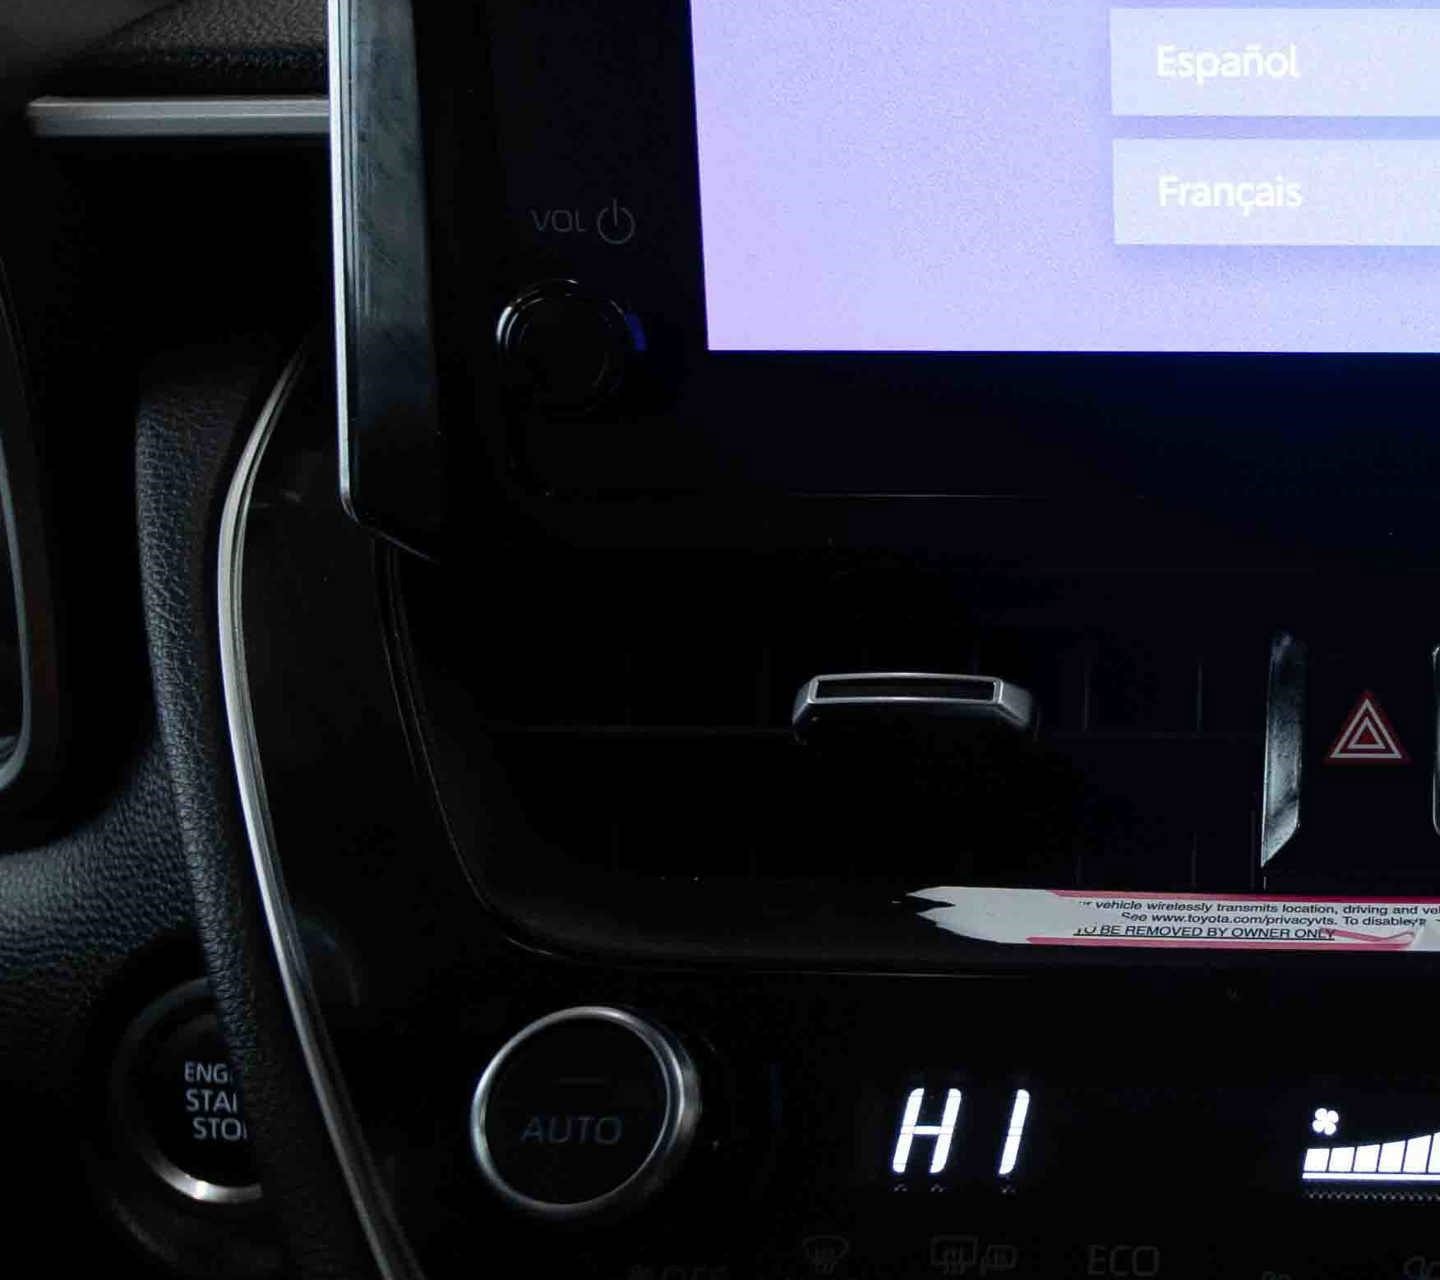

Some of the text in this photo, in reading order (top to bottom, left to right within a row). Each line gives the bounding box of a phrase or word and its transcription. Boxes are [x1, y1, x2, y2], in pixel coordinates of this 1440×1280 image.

[1157, 44, 1300, 85] Español
[1158, 176, 1303, 217] Français
[528, 208, 588, 233] VOL
[1096, 901, 1142, 911] vehicle
[1147, 902, 1212, 914] wirelessly
[1217, 903, 1277, 913] transmits
[1282, 904, 1338, 915] location,
[1343, 905, 1388, 916] driving
[1392, 905, 1418, 915] and
[1152, 913, 1338, 927] www.toyota.com/privacyvts.
[1343, 916, 1359, 926] To
[1100, 925, 1121, 935] BE
[1125, 925, 1202, 937] REMOVED
[1207, 927, 1228, 937] BY
[1231, 928, 1290, 938] OWNER
[1294, 928, 1335, 939] ONLY
[183, 1060, 229, 1085] ENG
[191, 1116, 249, 1142] STO
[520, 1114, 625, 1146] AUTO
[1086, 1243, 1161, 1278] ECO
